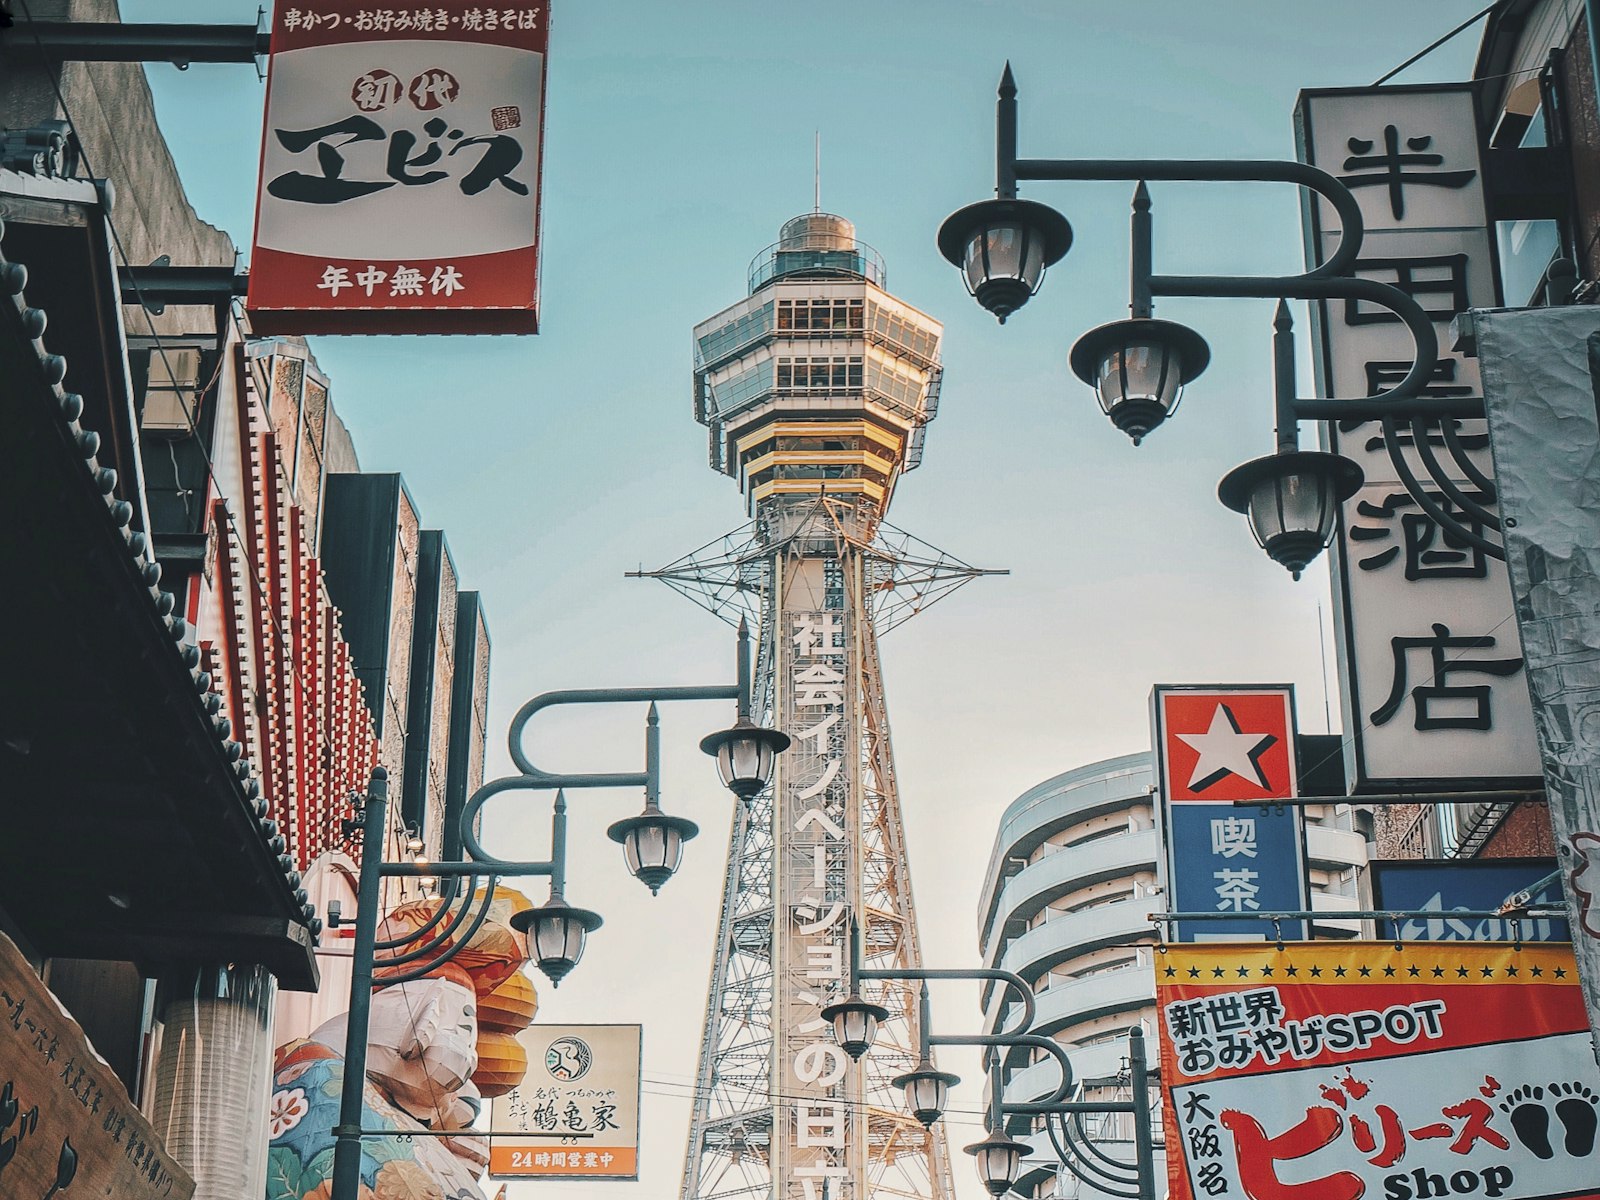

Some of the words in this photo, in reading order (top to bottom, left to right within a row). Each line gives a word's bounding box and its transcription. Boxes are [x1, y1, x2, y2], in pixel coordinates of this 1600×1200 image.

[284, 8, 540, 32] 串かつ・お好み焼き・焼きそば
[351, 68, 460, 112] 初代
[267, 115, 530, 204] エビス
[316, 265, 465, 297] 年中無休
[1210, 816, 1261, 912] 喫茶
[1168, 990, 1283, 1039] 新世界
[1179, 1003, 1443, 1072] おみやげSPOT
[532, 1100, 621, 1132] 鶴亀家
[512, 1152, 614, 1168] 24時間営業中
